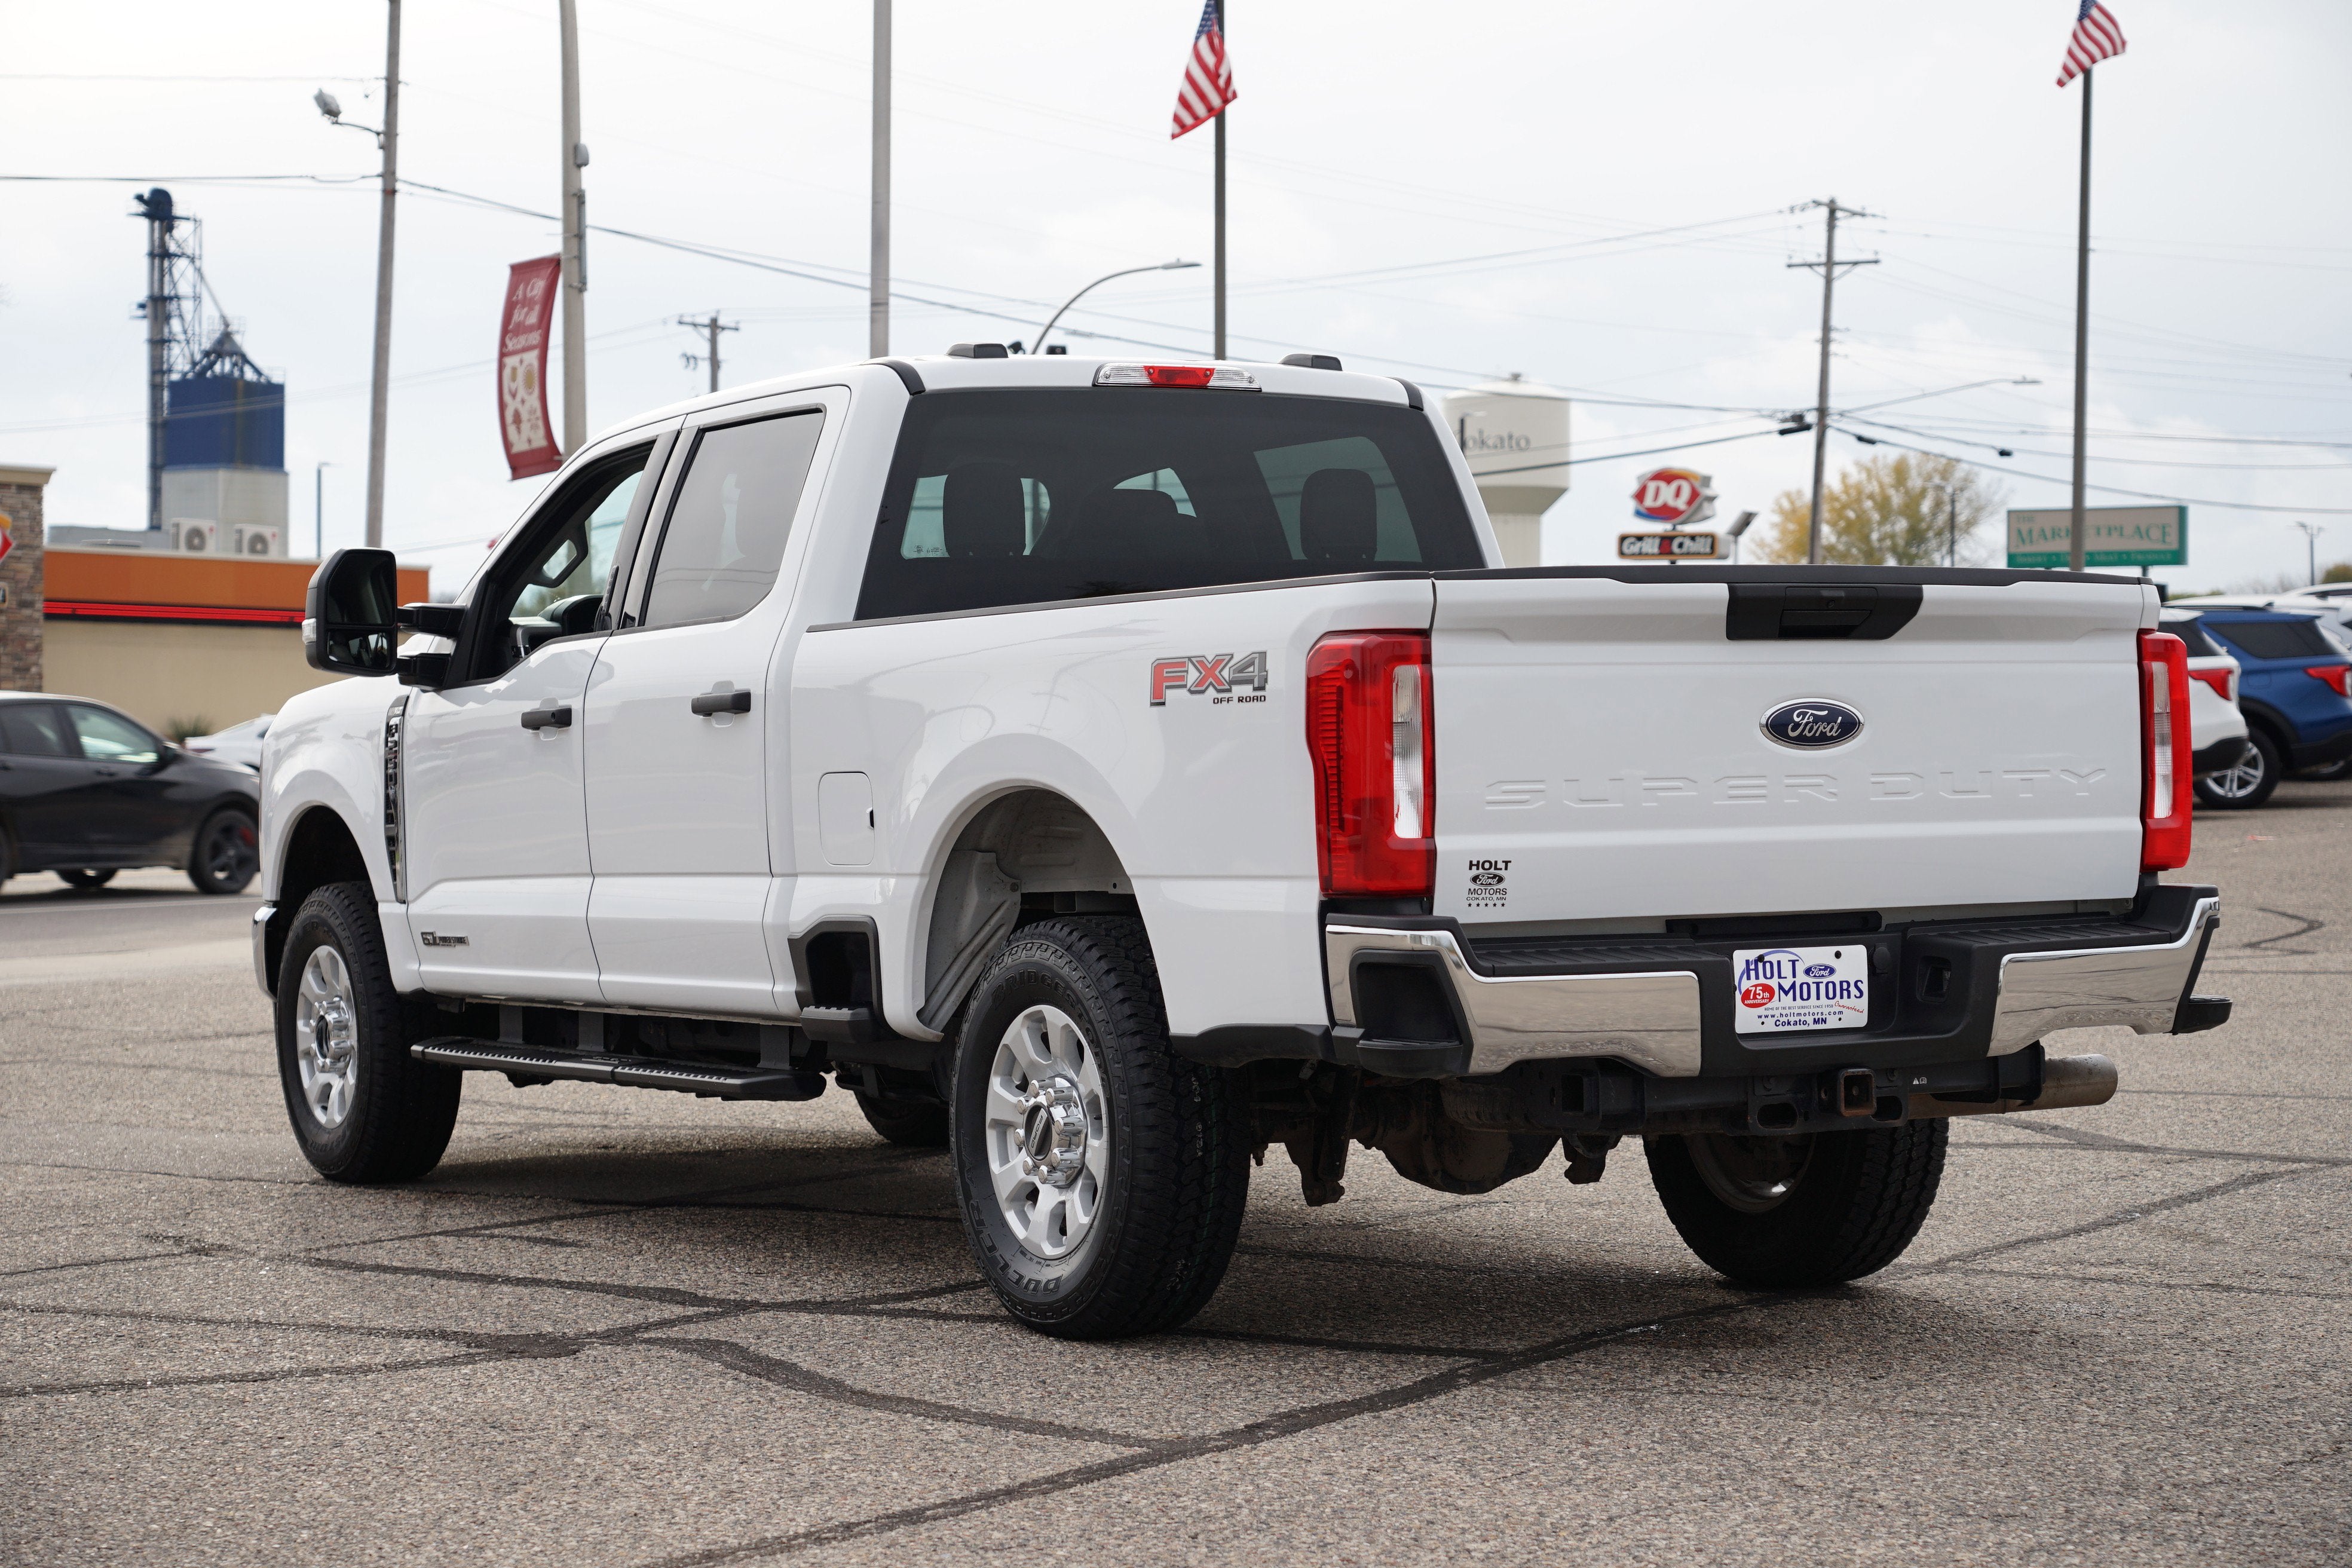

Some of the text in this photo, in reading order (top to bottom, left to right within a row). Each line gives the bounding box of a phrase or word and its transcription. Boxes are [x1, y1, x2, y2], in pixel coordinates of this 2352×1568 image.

[512, 281, 524, 301] A
[508, 304, 529, 330] for
[503, 329, 541, 353] Seasons
[1456, 428, 1531, 452] okato
[1643, 478, 1692, 510] DQ
[1621, 535, 1660, 555] Grill
[1671, 534, 1713, 555] Chill
[1149, 650, 1268, 708] FX4
[1212, 695, 1267, 705] OFF ROAD
[1787, 709, 1843, 740] Ford
[1484, 768, 2107, 810] SUPER DUTY
[1468, 859, 1512, 871] HOLT
[1476, 873, 1499, 885] Ford
[1468, 887, 1508, 896] MOTORS
[1745, 958, 1800, 981] HOLT
[1809, 966, 1830, 978] Ford
[1748, 986, 1770, 1000] 75th
[1778, 979, 1864, 1003] MOTORS
[1757, 1010, 1843, 1019] www.holtmotors.com
[1834, 1000, 1864, 1014] Guaranteed
[1774, 1018, 1810, 1027] Cokato,
[1031, 1114, 1043, 1149] FORD
